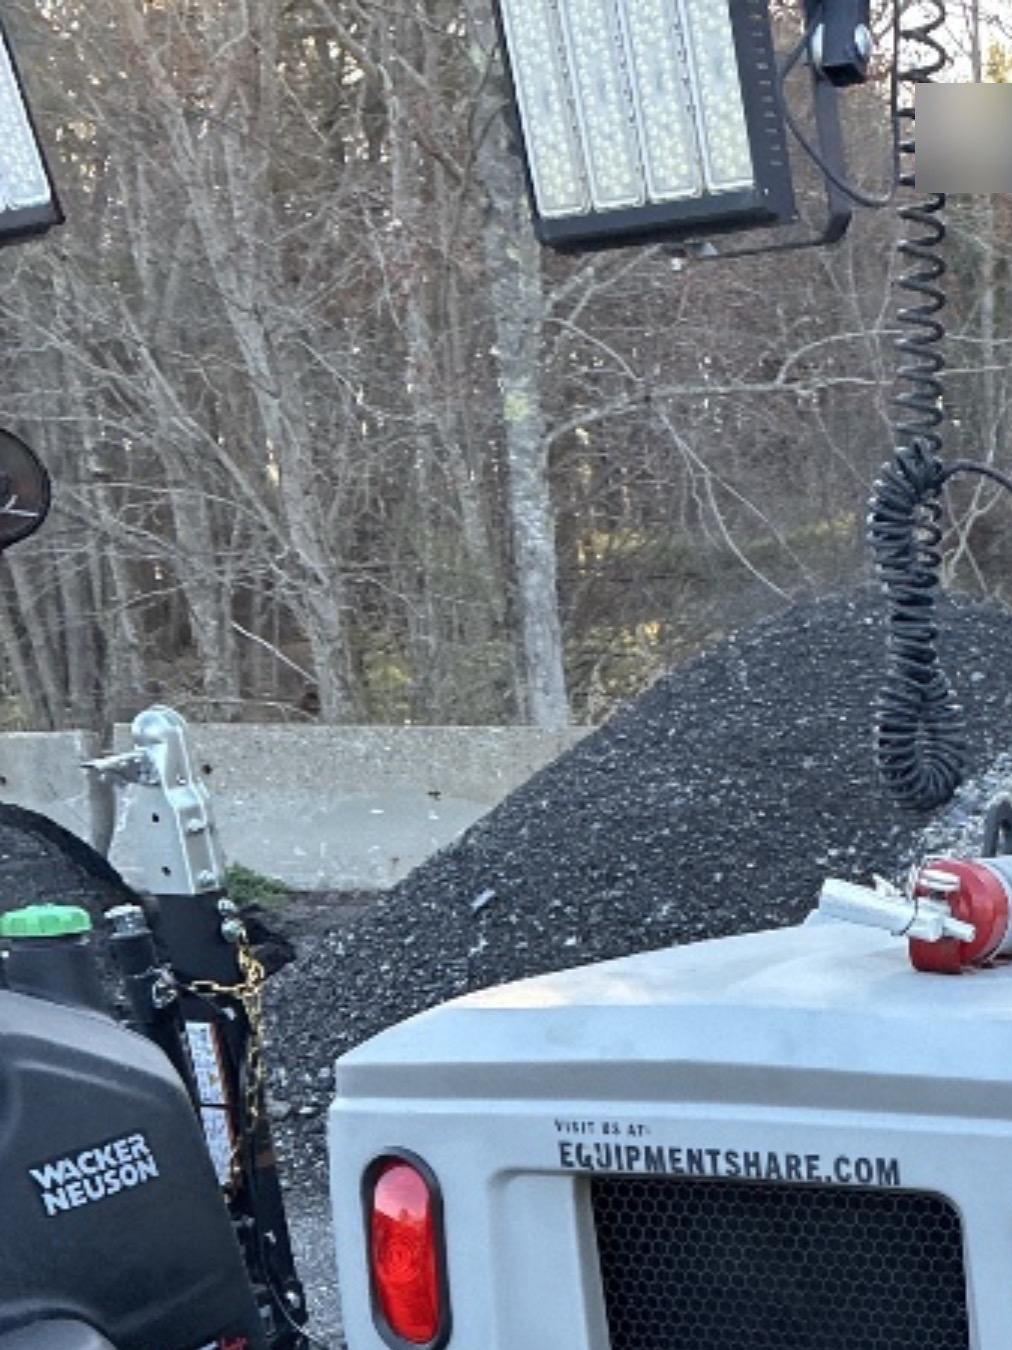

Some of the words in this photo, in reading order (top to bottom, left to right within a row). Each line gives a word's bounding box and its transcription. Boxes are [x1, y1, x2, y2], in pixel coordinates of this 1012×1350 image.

[29, 1132, 151, 1190] WACKER
[41, 1153, 160, 1217] NEUSON
[557, 1140, 901, 1187] EQUIPMENTSHARE.COM
